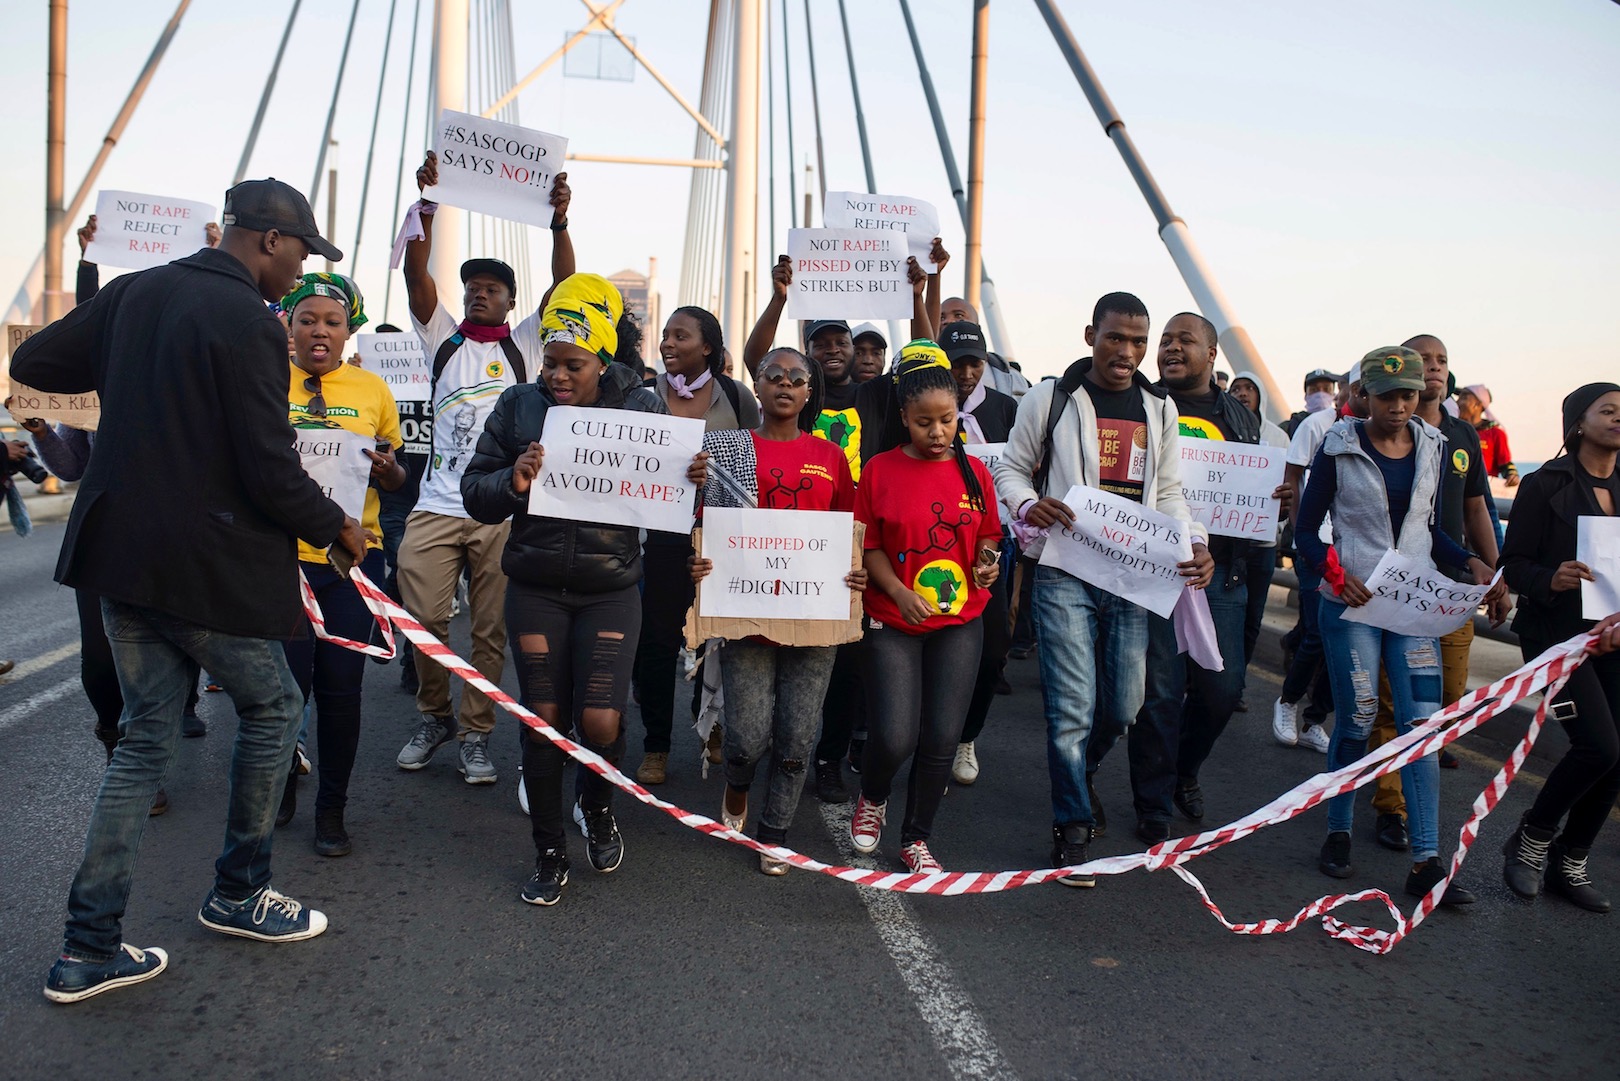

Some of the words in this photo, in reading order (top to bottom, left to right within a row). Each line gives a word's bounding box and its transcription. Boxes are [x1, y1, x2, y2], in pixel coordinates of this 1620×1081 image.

[444, 124, 547, 162] #SASCOGP
[442, 149, 494, 175] SAYS
[500, 162, 549, 188] NO!!!
[116, 200, 149, 214] NOT
[152, 204, 191, 219] RAPE
[846, 200, 876, 212] NOT
[880, 203, 917, 216] RAPE
[123, 220, 182, 236] REJECT
[854, 218, 910, 232] REJECT
[129, 239, 170, 254] RAPE
[809, 240, 840, 251] NOT
[843, 240, 890, 251] RAPE!!
[798, 260, 851, 272] PISSED
[855, 260, 875, 272] OF
[880, 260, 901, 272] BY
[800, 280, 863, 292] STRIKES
[868, 280, 900, 292] BUT
[374, 342, 423, 352] CULTU
[381, 358, 411, 369] HOW
[382, 375, 408, 384] OID
[18, 396, 40, 410] DO
[48, 395, 61, 410] IS
[69, 396, 101, 410] KILL
[290, 403, 356, 416] REVTION
[571, 420, 671, 447] CULTURE
[1104, 440, 1120, 454] BE
[574, 447, 626, 469] HOW
[632, 454, 660, 473] TO
[1181, 447, 1269, 469] FRUSTRATED
[804, 464, 827, 472] SASCO
[1207, 470, 1227, 483] BY
[543, 472, 613, 494] AVOID
[619, 480, 685, 503] RAPE?
[1182, 488, 1232, 504] RAFFICE
[1236, 494, 1268, 508] BUT
[1084, 499, 1113, 517] MY
[1115, 510, 1163, 537] BODY
[1165, 530, 1181, 545] IS
[1210, 505, 1270, 533] RAPE
[728, 536, 804, 551] STRIPPED
[808, 539, 828, 551] OF
[1100, 525, 1136, 547] NOT
[1136, 542, 1148, 554] A
[1061, 527, 1178, 581] COMMODITY!!!
[765, 556, 792, 570] MY
[1382, 565, 1482, 603] #SASCOG
[1373, 585, 1432, 612] SAYS
[1433, 604, 1473, 616] NO!
